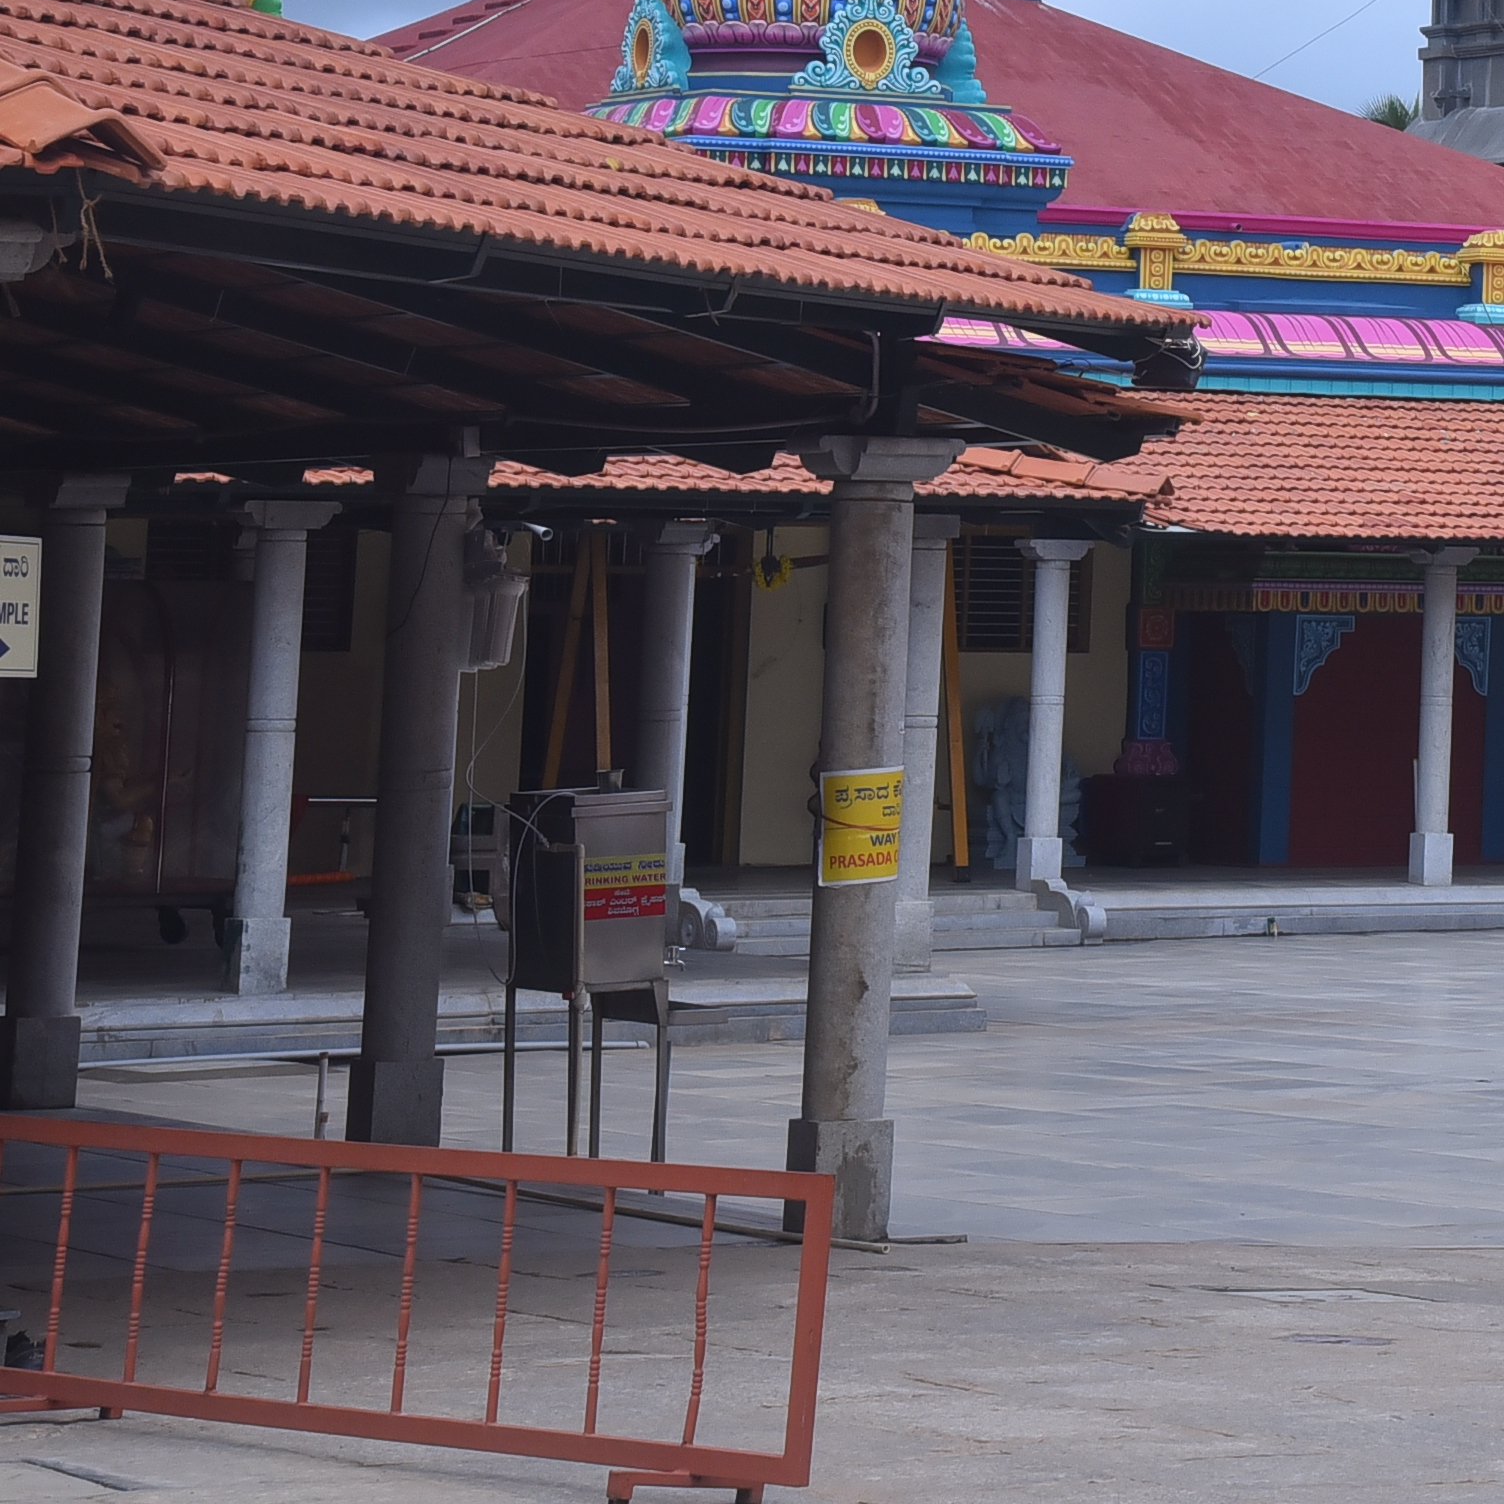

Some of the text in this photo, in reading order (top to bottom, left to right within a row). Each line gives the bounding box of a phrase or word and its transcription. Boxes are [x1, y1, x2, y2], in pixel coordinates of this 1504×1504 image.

[3, 556, 29, 578] ದಾರಿ
[835, 782, 890, 810] ಪ್ರಸಾದ
[870, 832, 897, 847] WAY
[829, 850, 892, 870] PRASADA
[585, 873, 666, 886] RINKING WATER
